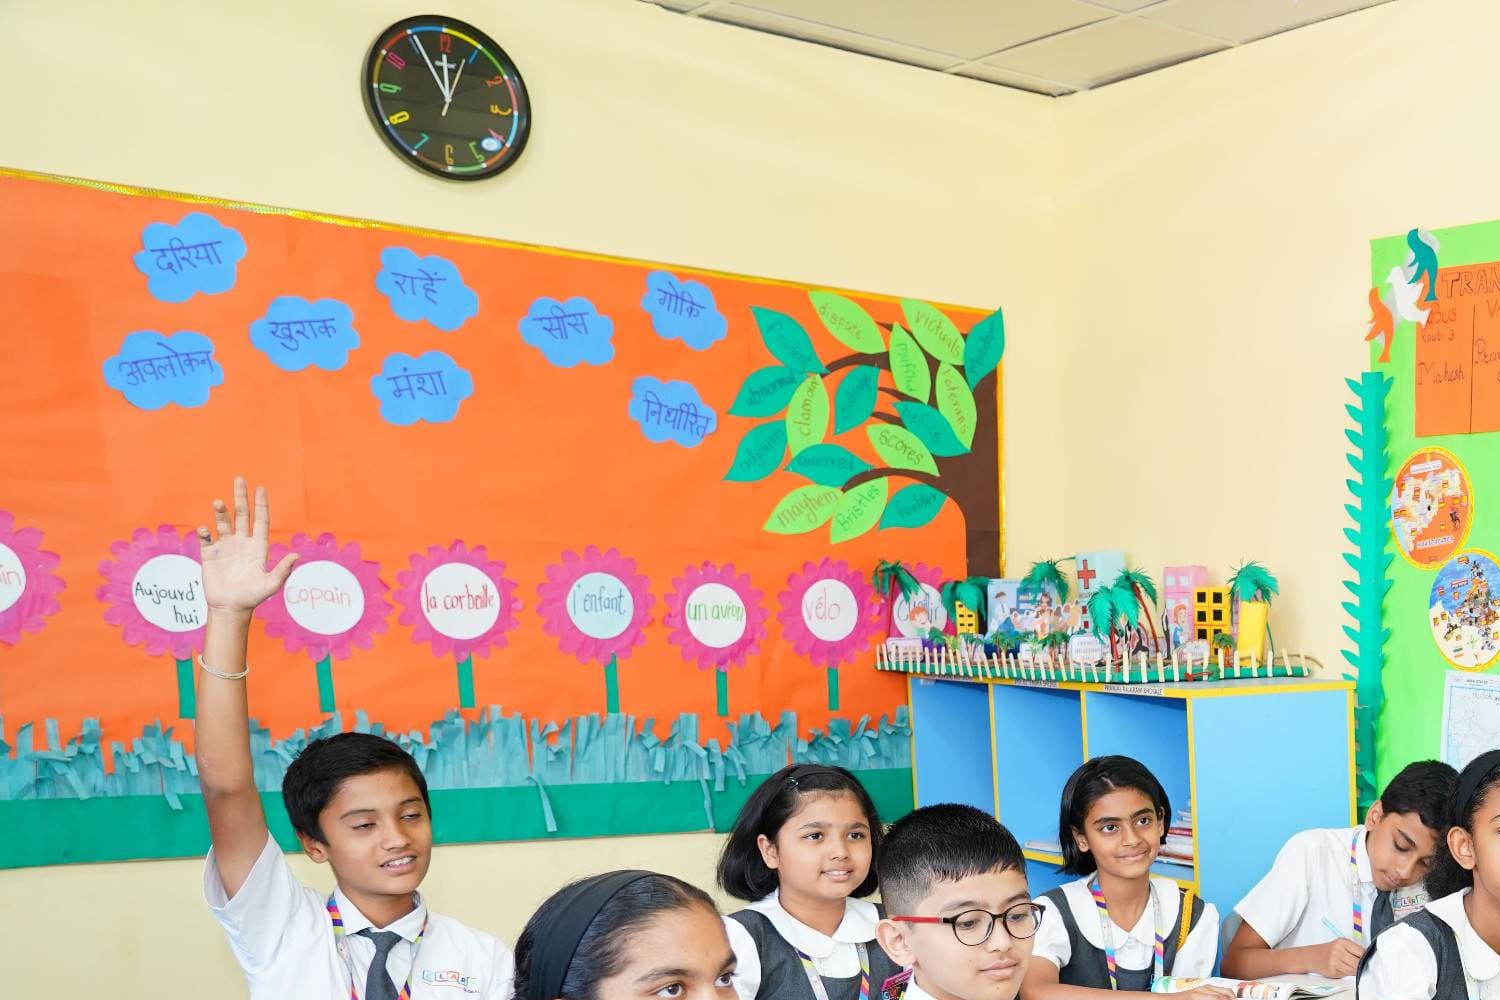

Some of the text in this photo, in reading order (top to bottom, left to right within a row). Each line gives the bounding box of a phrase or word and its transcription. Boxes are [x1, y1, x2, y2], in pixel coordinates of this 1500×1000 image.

[386, 52, 406, 71] 10
[379, 83, 402, 94] 9
[485, 75, 503, 88] 2
[389, 111, 410, 125] 8
[490, 105, 512, 116] 3
[414, 132, 430, 149] 7
[444, 144, 454, 165] 6
[150, 238, 223, 275] दरिया
[391, 268, 447, 304] राहें
[269, 318, 336, 351] खुराक
[118, 342, 214, 386] अवलोकन
[1417, 362, 1466, 386] Mahesh
[386, 367, 448, 401] मंशा
[134, 580, 200, 605] Aujourd'
[425, 588, 438, 612] la
[174, 607, 200, 626] hui
